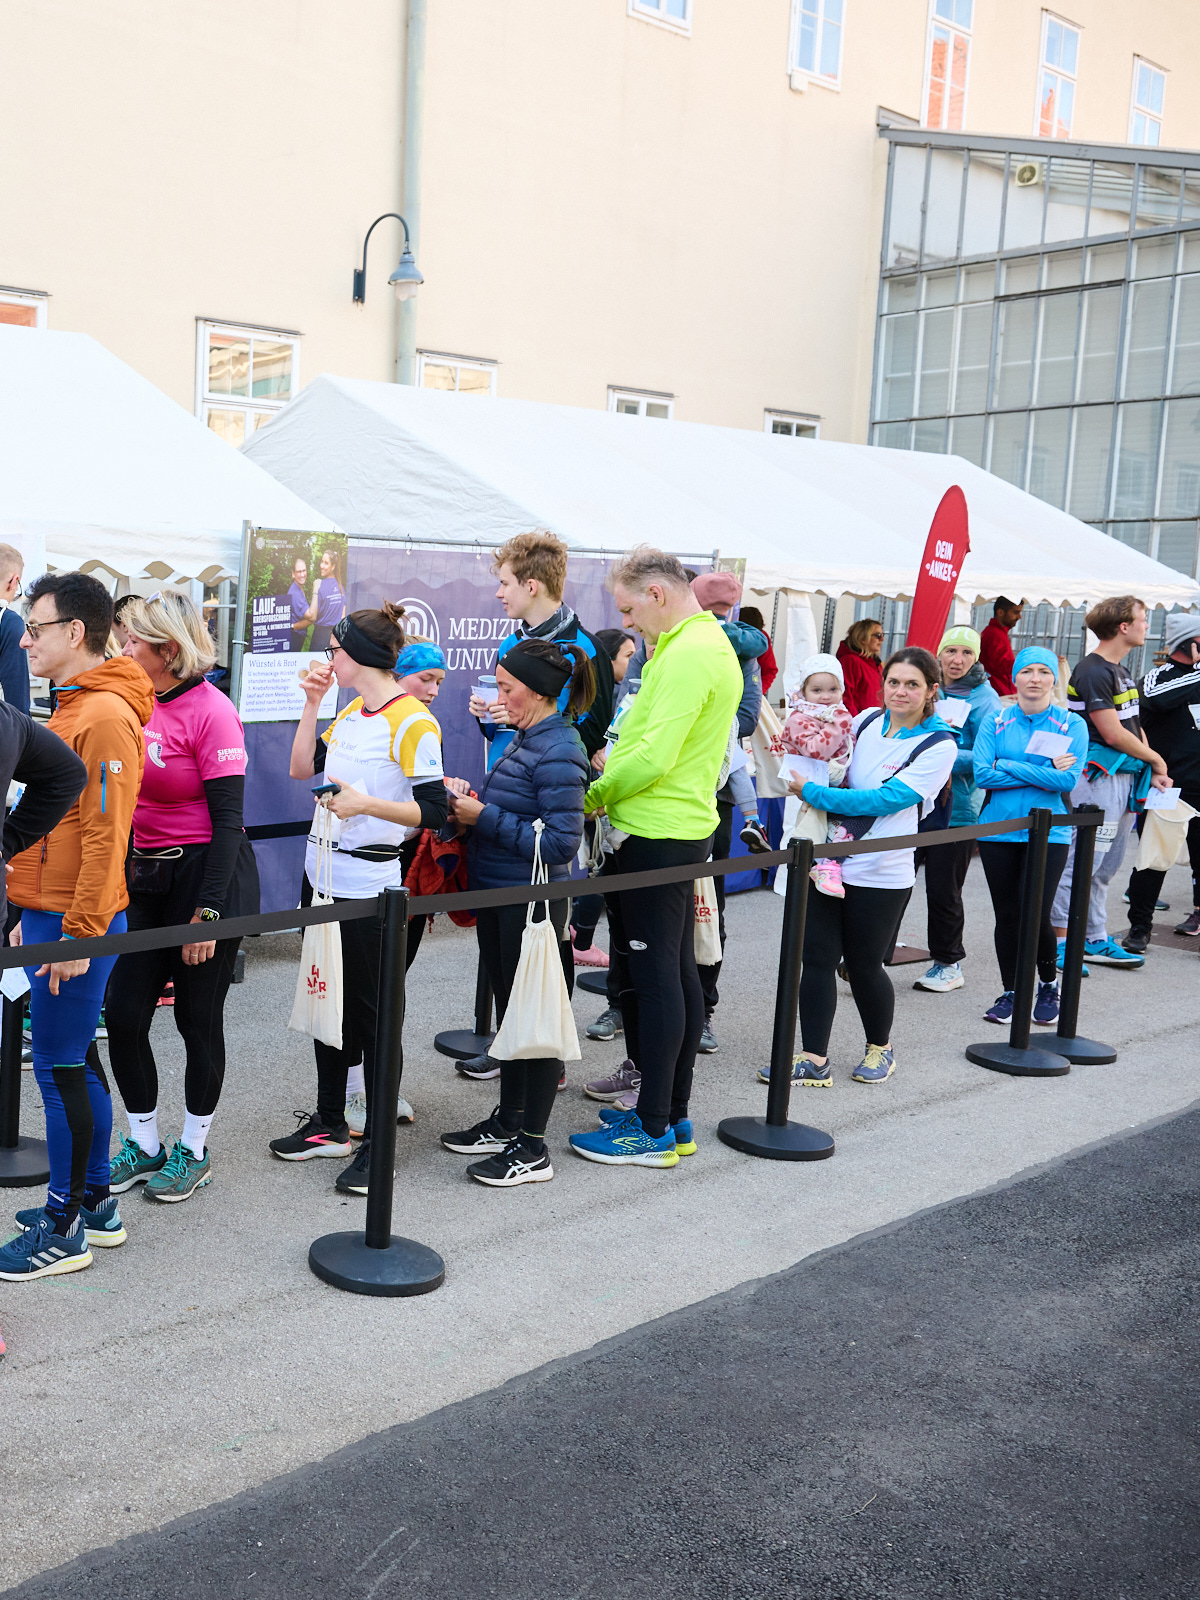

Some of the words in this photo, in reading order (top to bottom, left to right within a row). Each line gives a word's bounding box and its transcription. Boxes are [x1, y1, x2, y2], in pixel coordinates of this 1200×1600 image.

[935, 540, 954, 561] DEIN
[928, 560, 954, 583] ANKER
[253, 597, 276, 615] LAUF
[448, 617, 523, 640] MEDIZI
